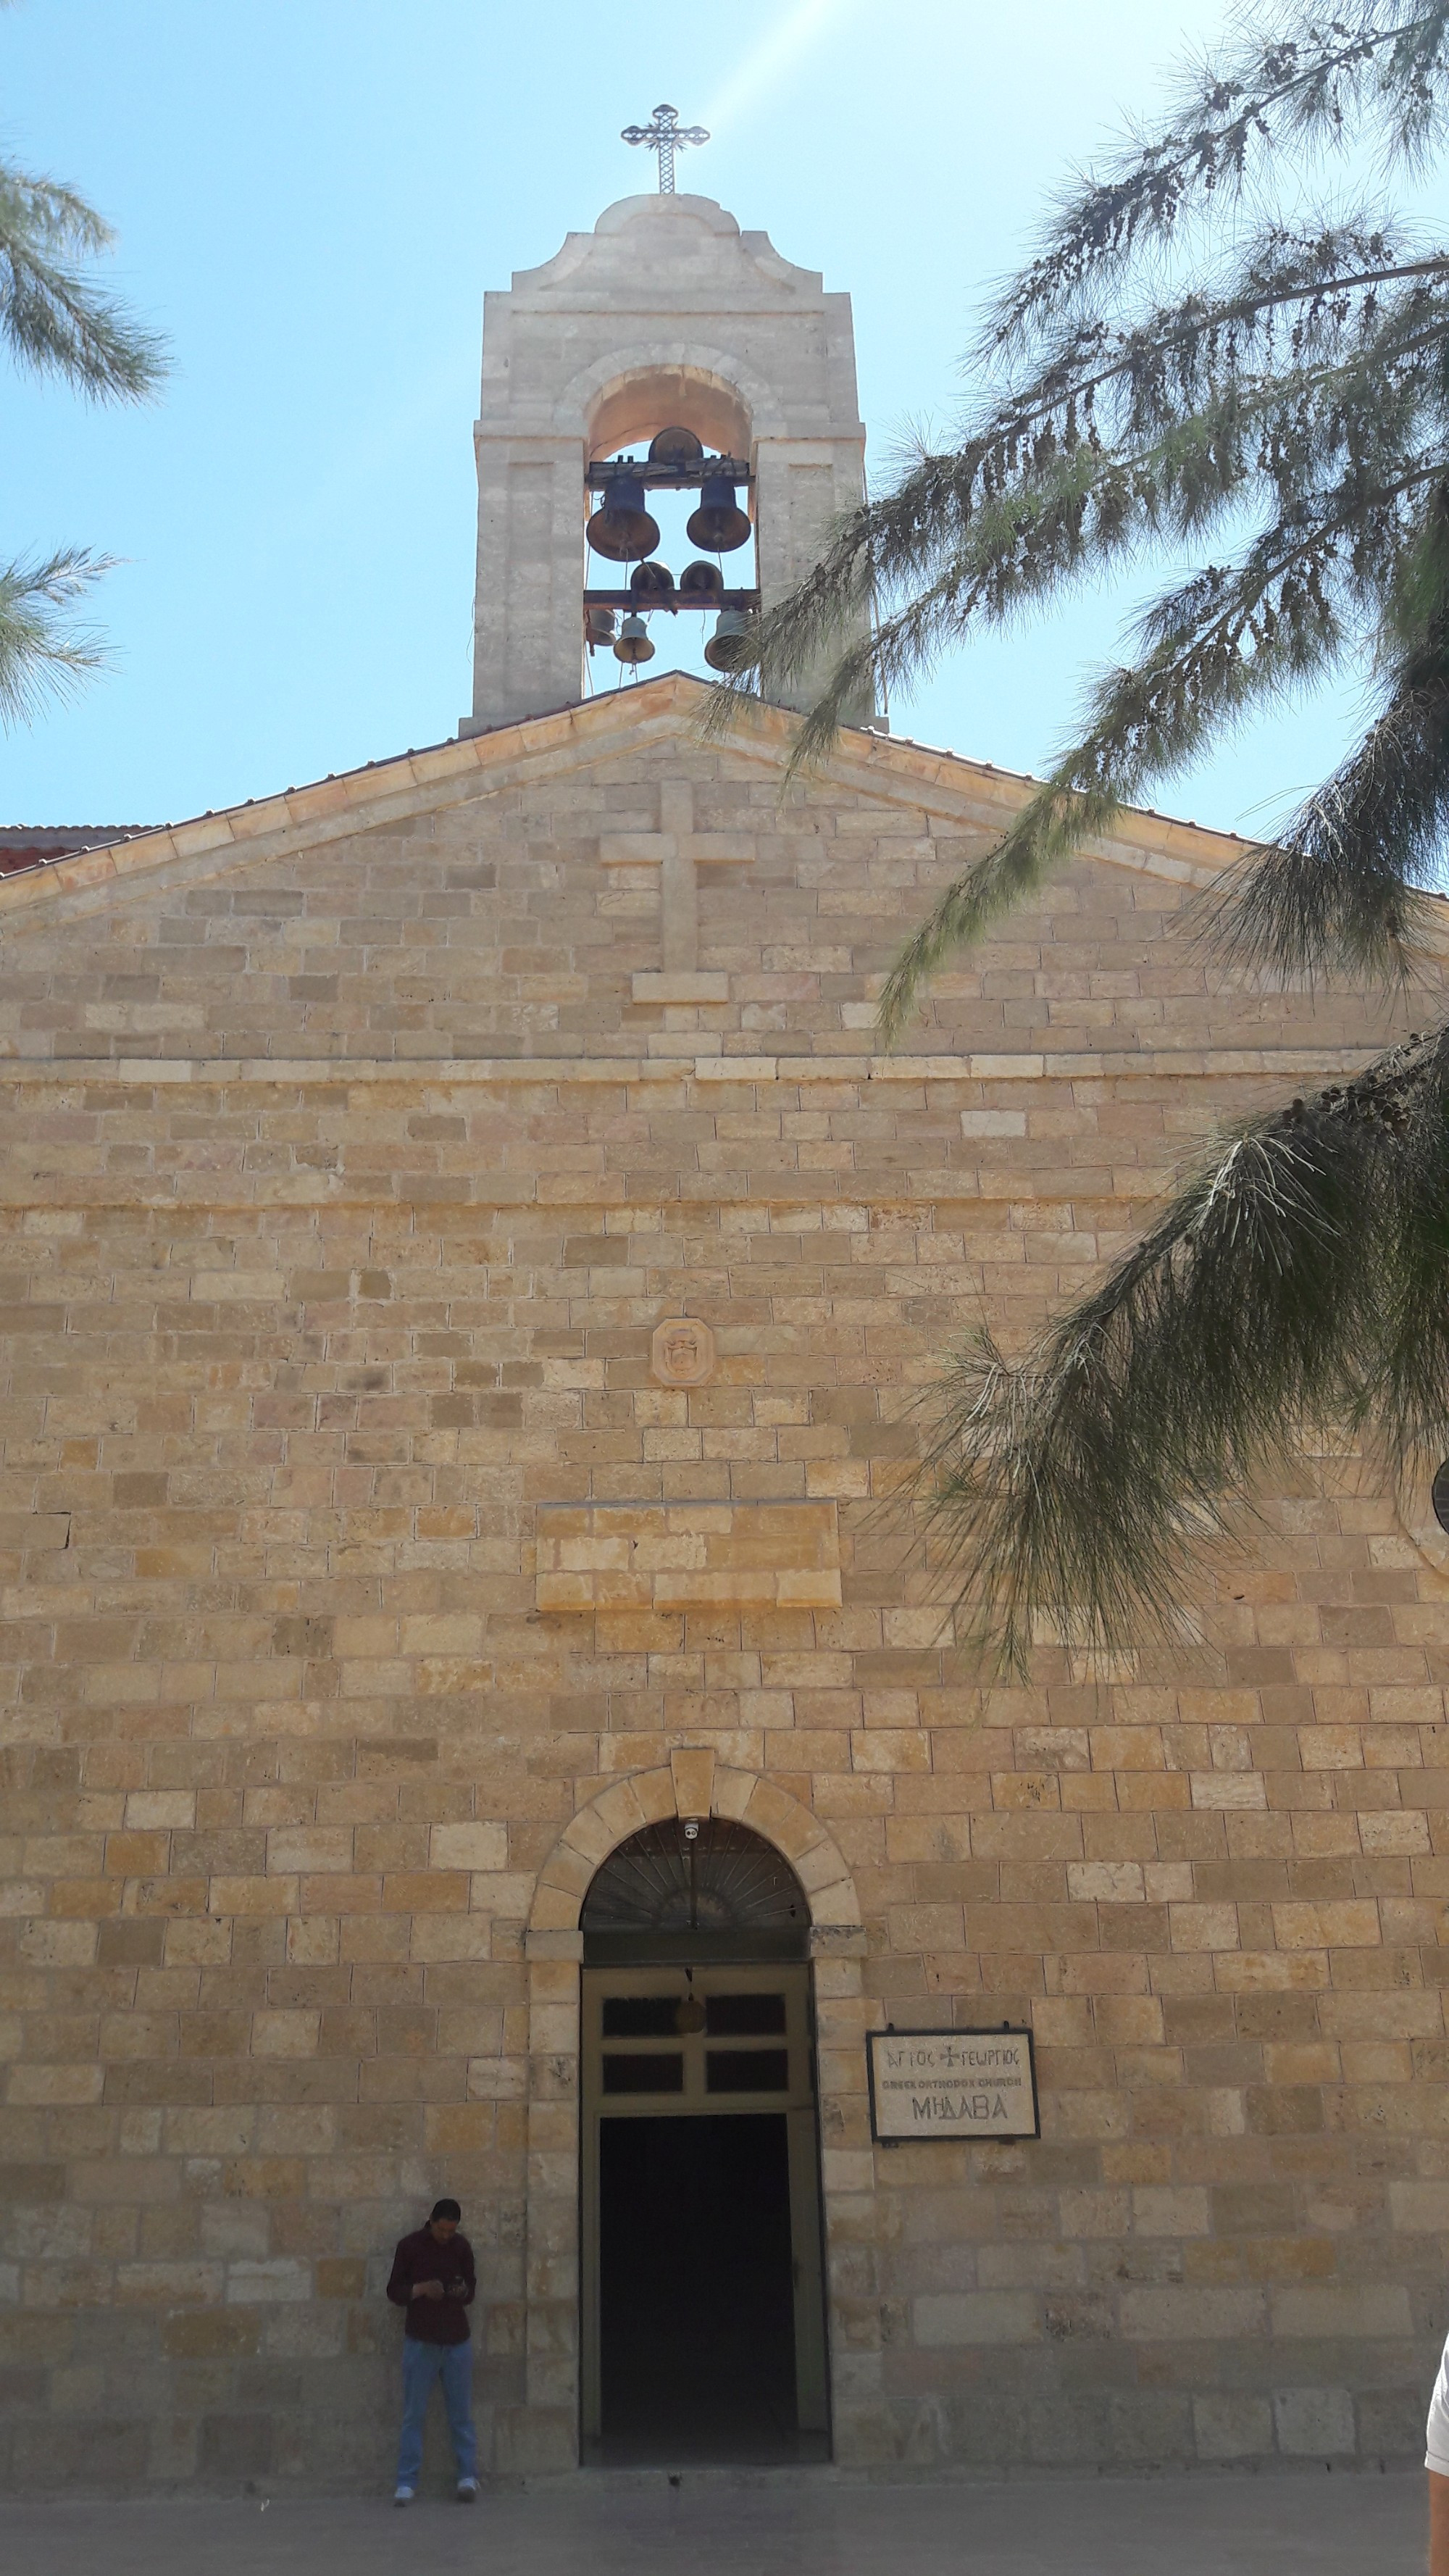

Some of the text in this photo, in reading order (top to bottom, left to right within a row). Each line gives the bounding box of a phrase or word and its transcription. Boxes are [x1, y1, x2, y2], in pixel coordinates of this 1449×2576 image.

[882, 2077, 1022, 2090] GREEK ORTHODOX CHURCH
